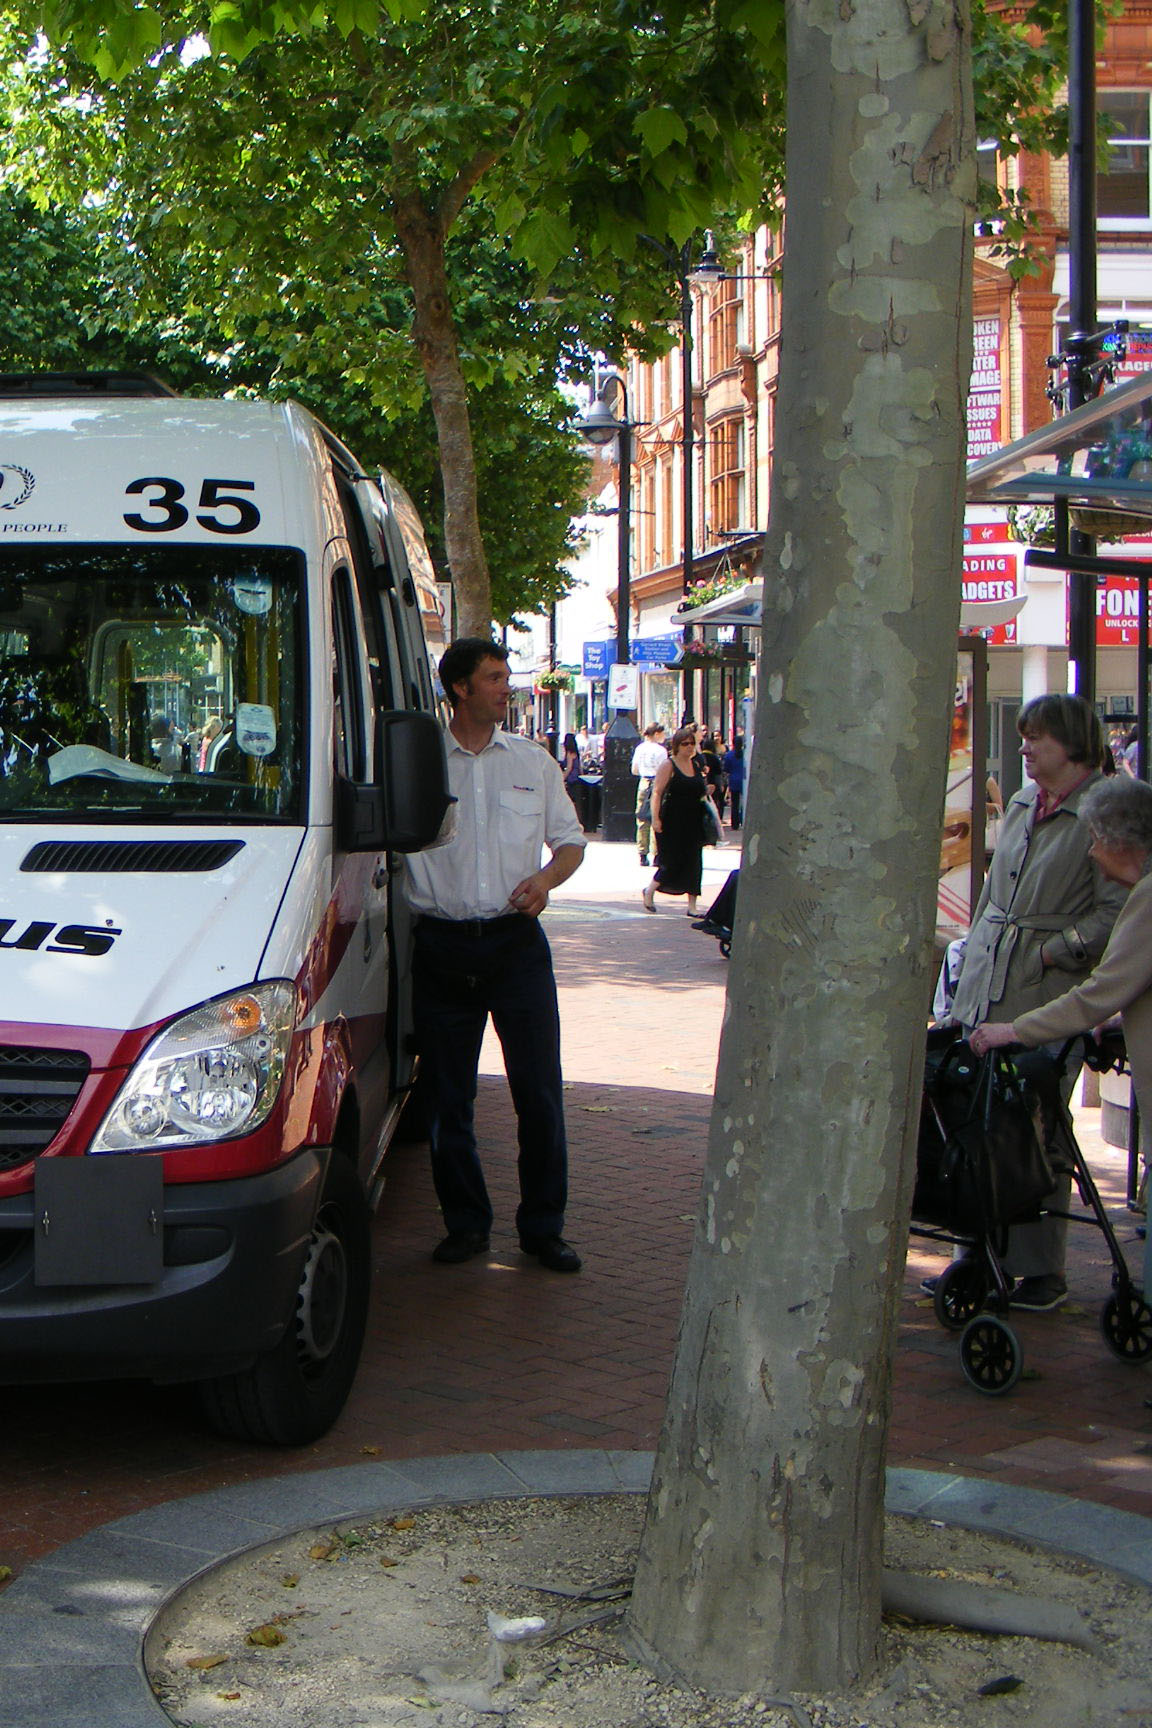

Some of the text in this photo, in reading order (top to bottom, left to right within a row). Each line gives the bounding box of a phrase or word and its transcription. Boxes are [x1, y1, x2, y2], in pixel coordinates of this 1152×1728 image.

[967, 428, 992, 442] DATA
[123, 476, 261, 535] 35
[2, 523, 69, 534] PEOPLE
[587, 646, 601, 655] The
[588, 654, 601, 663] Toy
[584, 662, 605, 671] Shop
